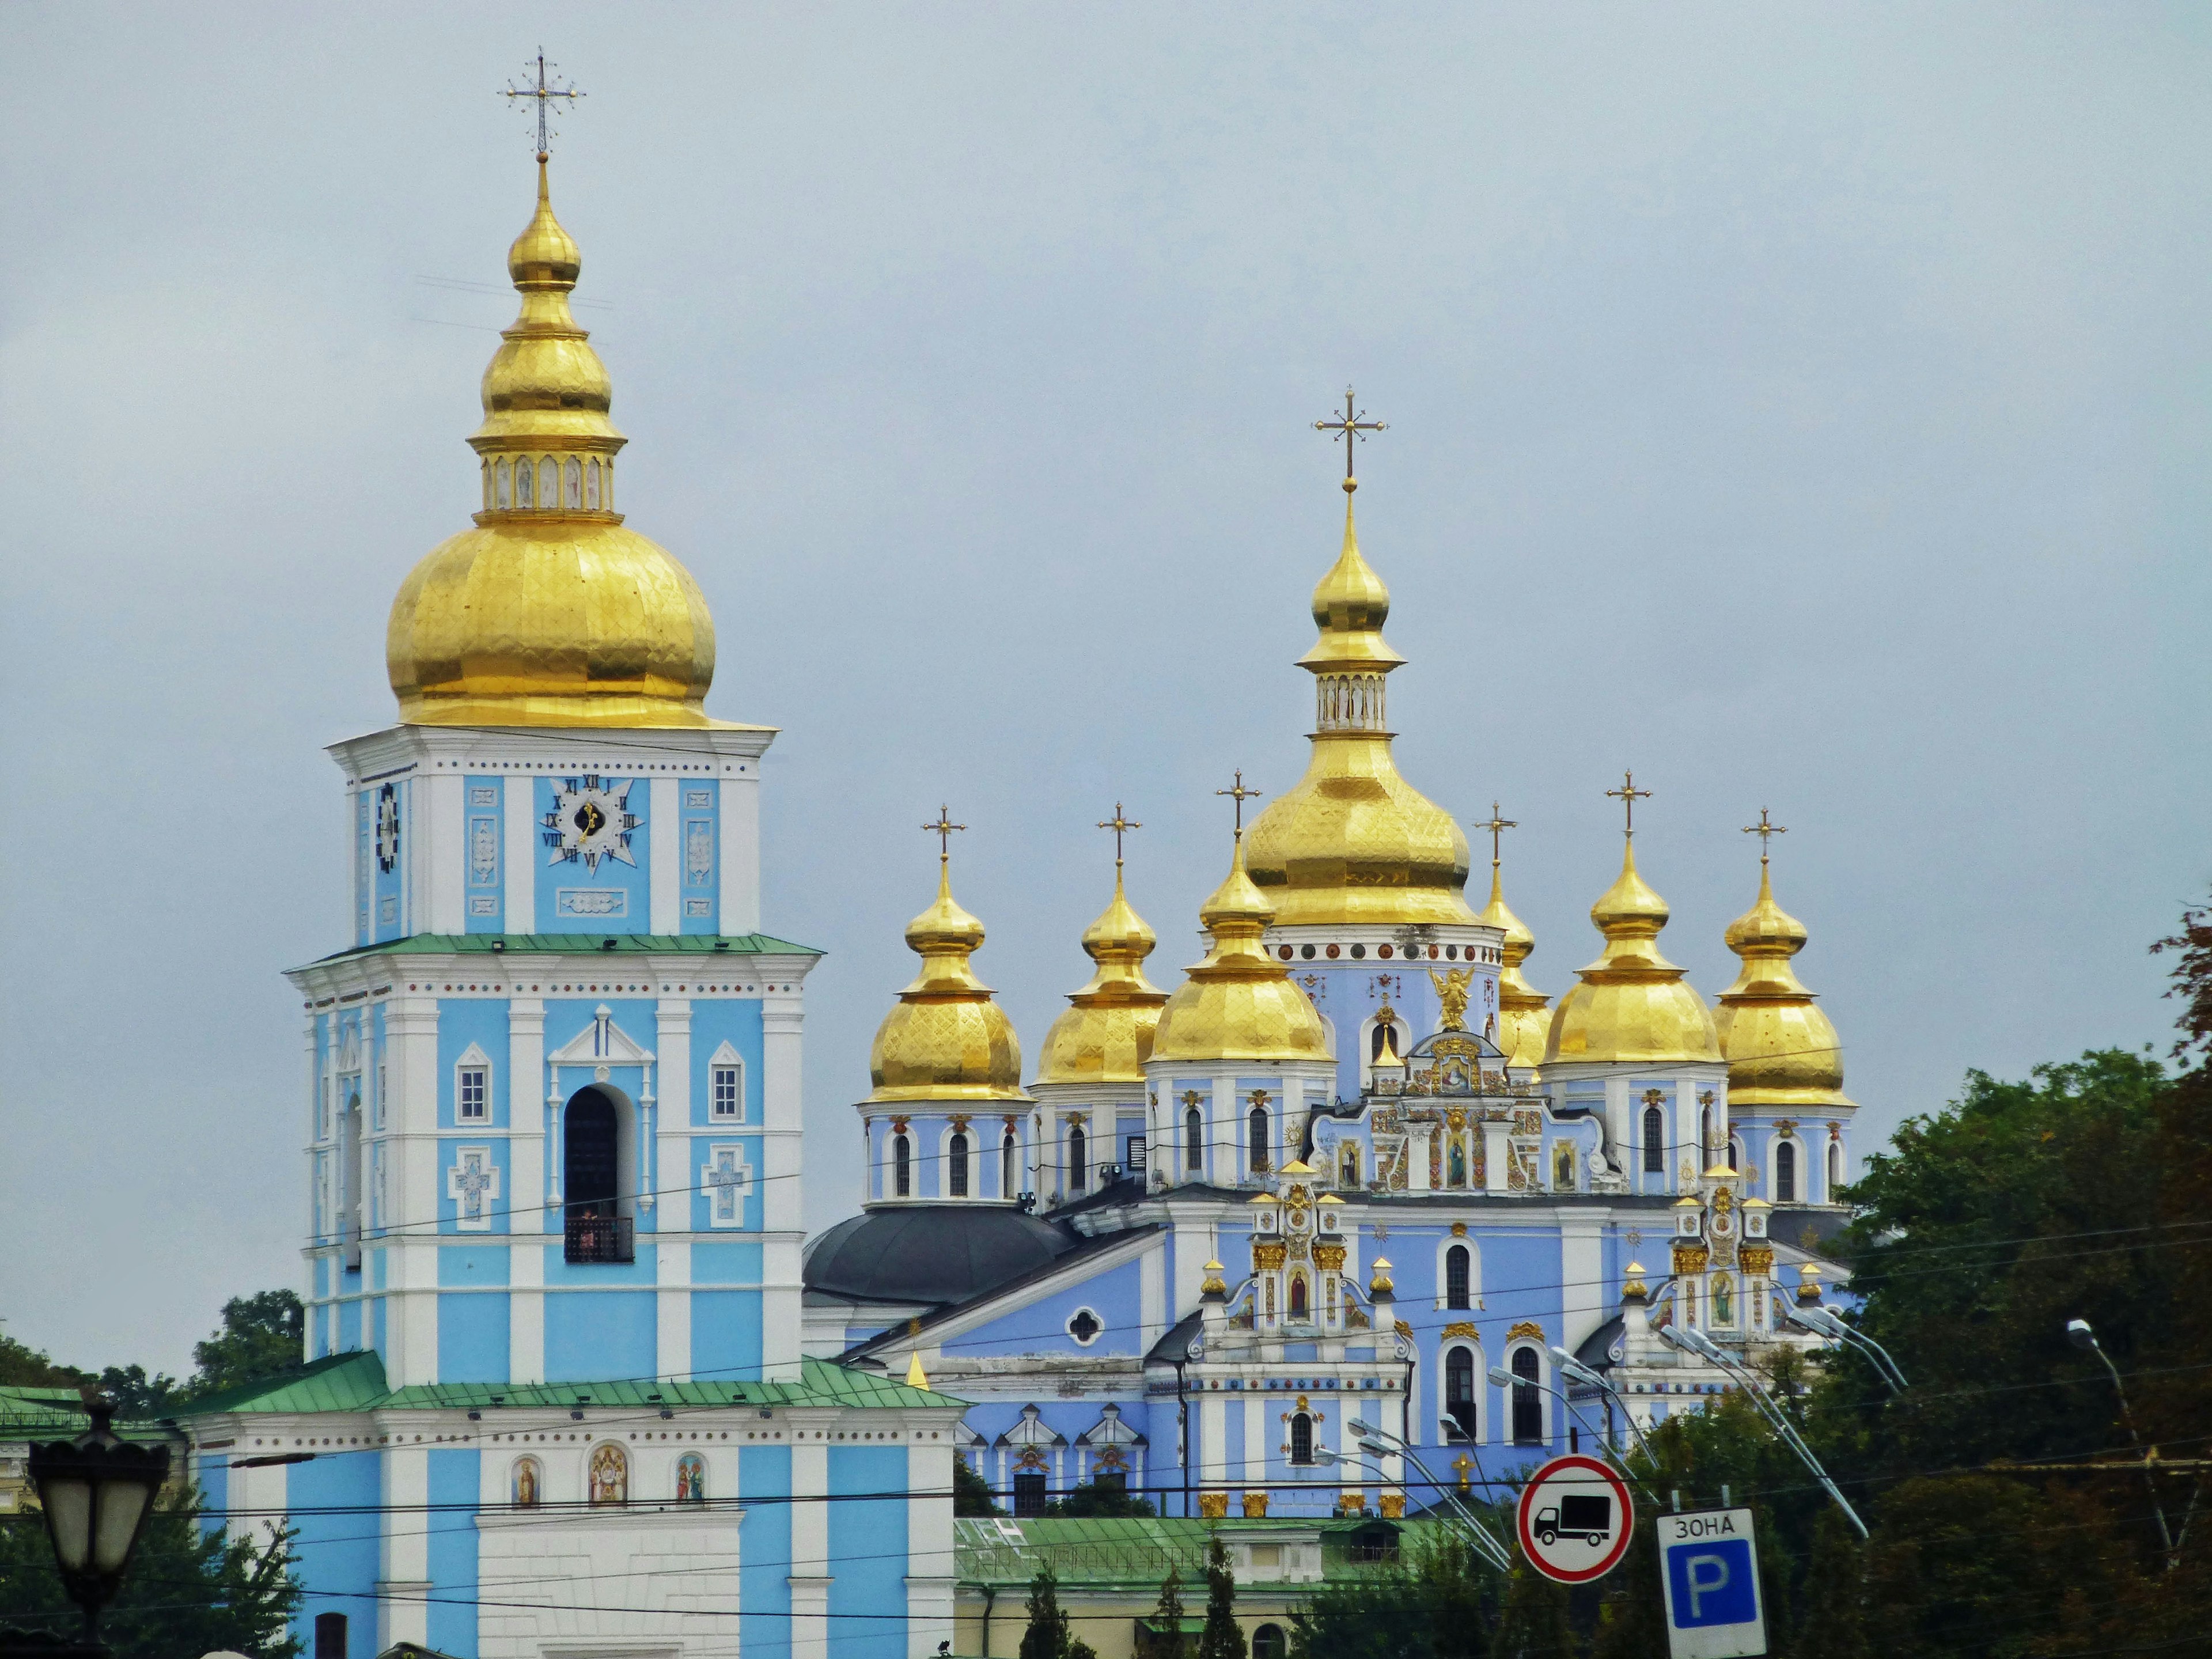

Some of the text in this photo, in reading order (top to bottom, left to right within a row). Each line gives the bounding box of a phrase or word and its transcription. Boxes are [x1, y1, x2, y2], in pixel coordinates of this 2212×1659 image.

[566, 779, 577, 793] XI
[584, 774, 599, 788] XII
[607, 779, 611, 793] I
[554, 796, 561, 809] X
[619, 796, 627, 810] II
[547, 813, 558, 827] IX
[624, 814, 635, 828] III
[543, 833, 562, 847] VIII
[620, 834, 631, 847] IV
[563, 848, 578, 862] VII
[584, 853, 596, 866] VI
[607, 849, 614, 862] V
[1676, 1516, 1735, 1538] ЗОНА
[1687, 1555, 1729, 1618] P
